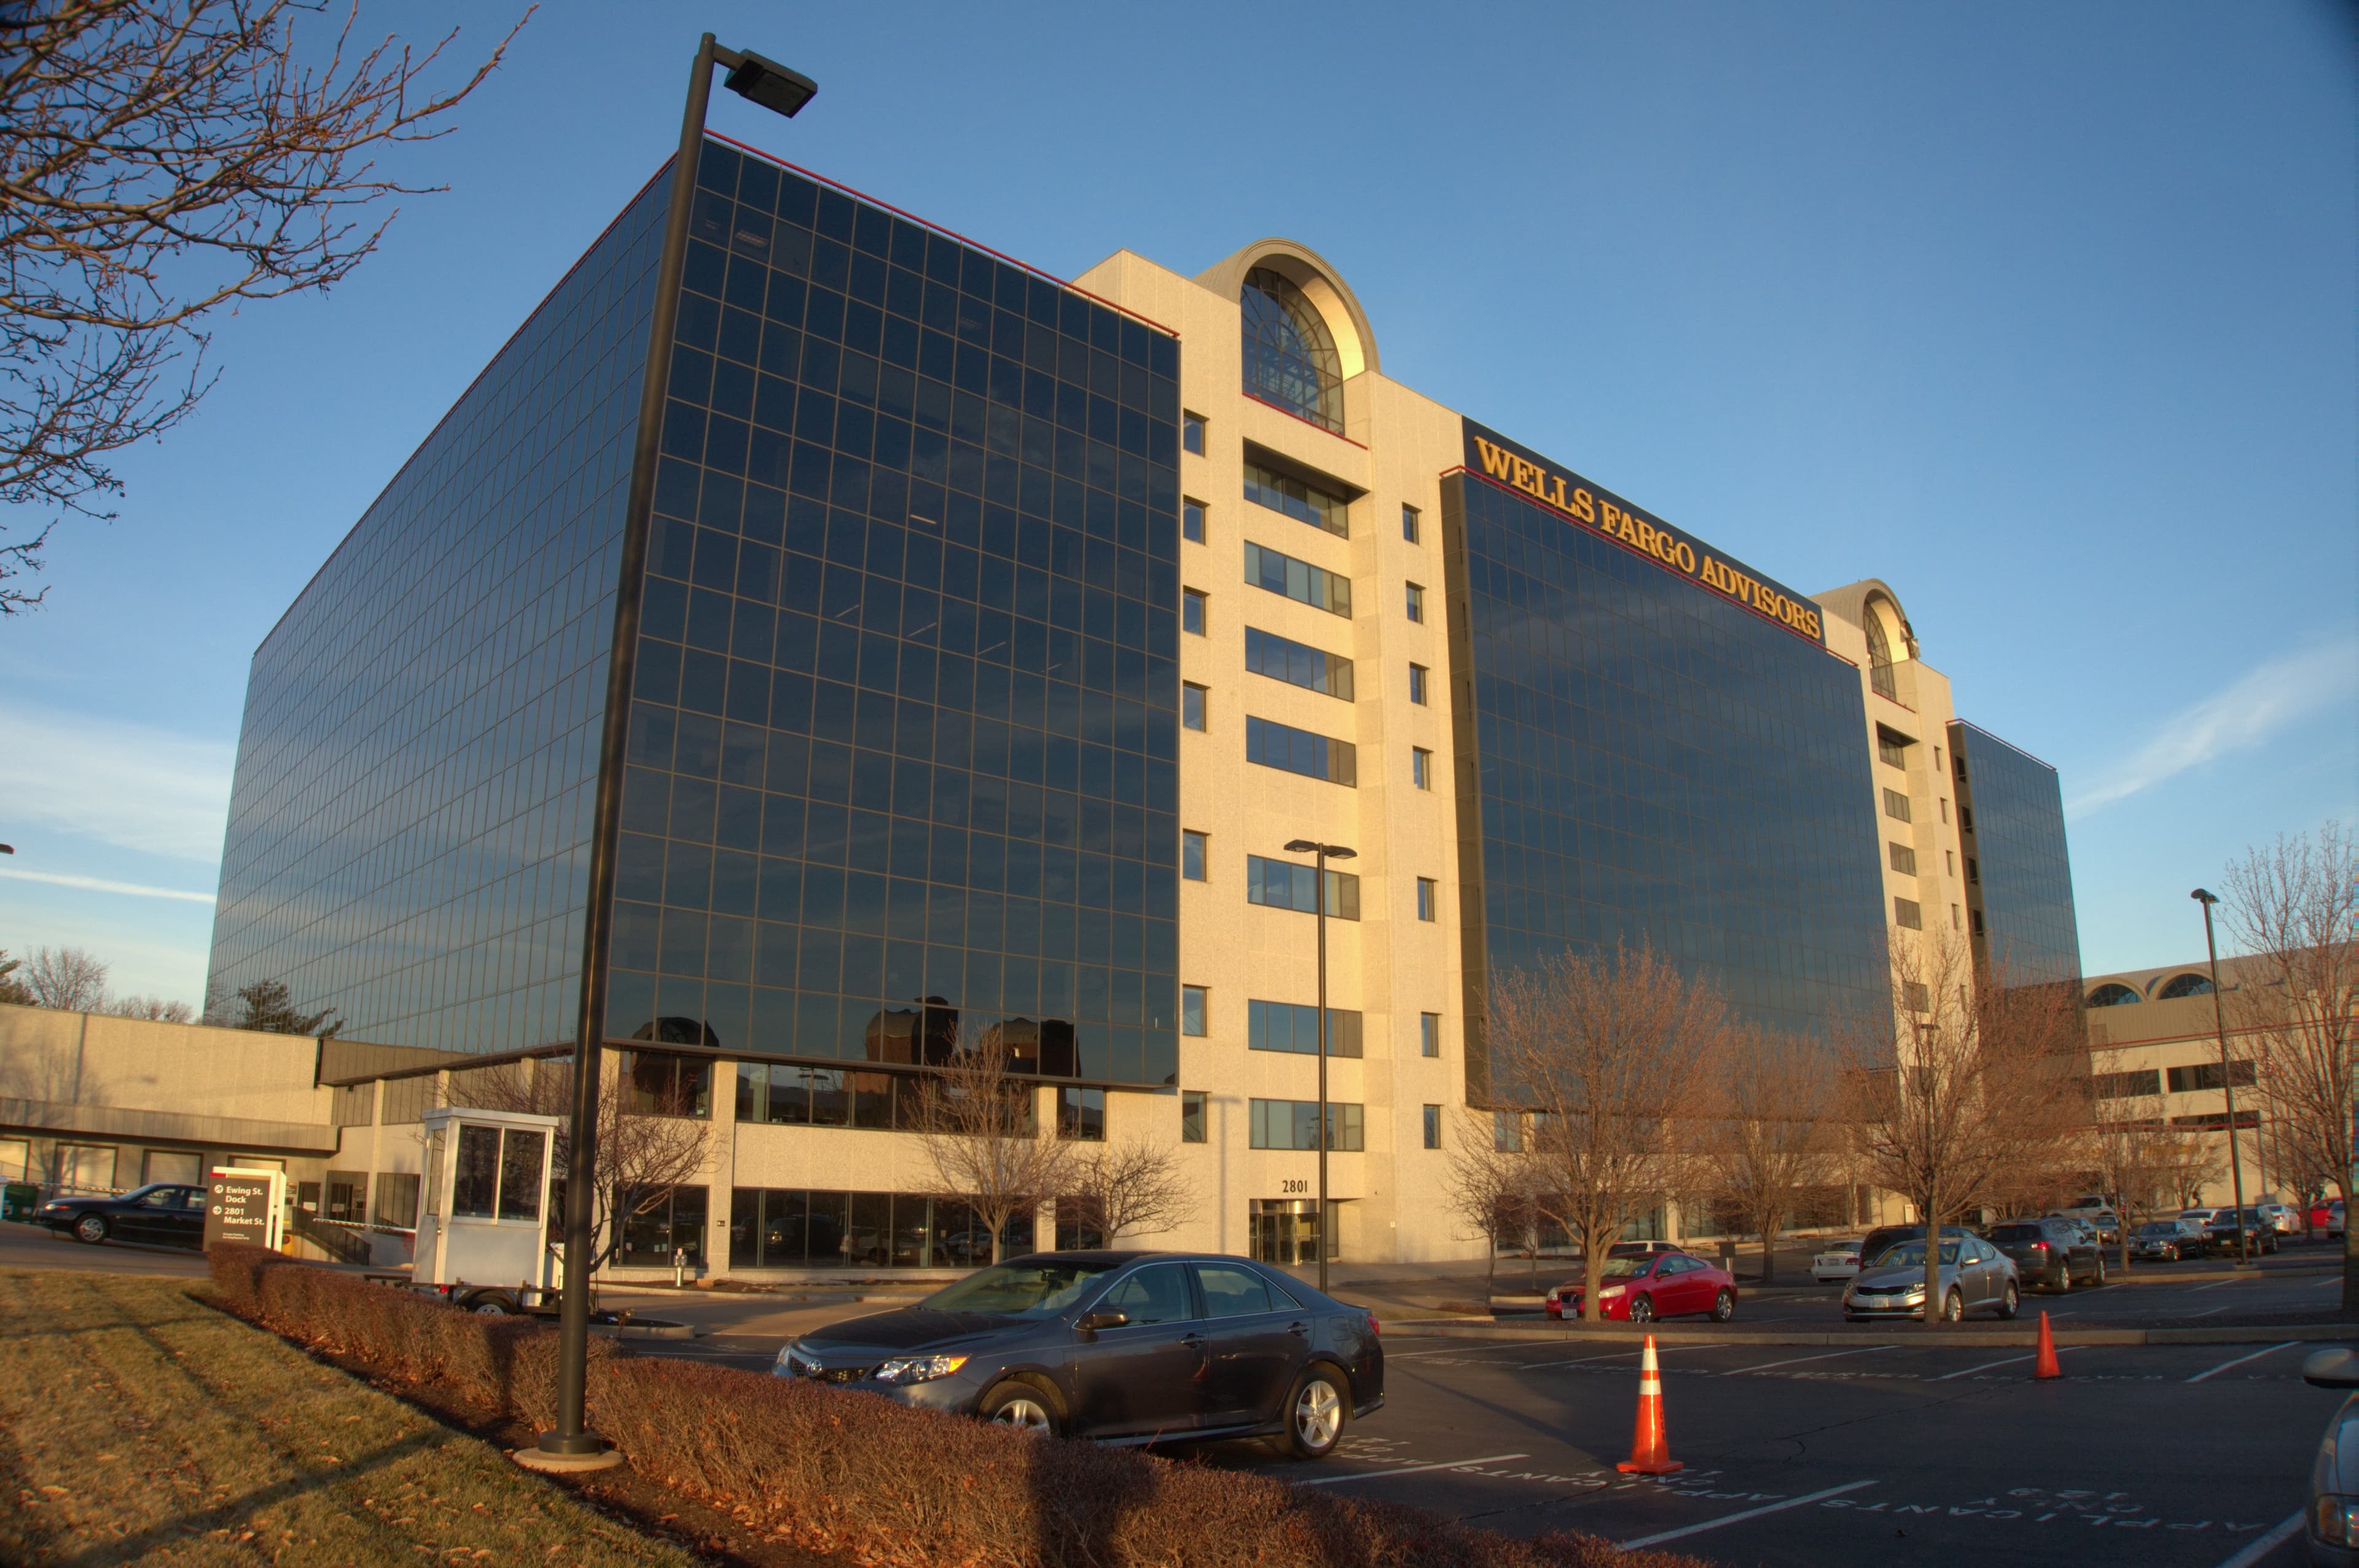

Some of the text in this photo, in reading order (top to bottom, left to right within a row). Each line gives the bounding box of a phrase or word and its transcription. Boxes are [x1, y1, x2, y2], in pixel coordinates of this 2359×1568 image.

[1474, 435, 1821, 640] WELLS FARGO ADVISORS
[226, 1186, 251, 1196] Ewing
[1282, 1180, 1307, 1193] 2801
[224, 1216, 252, 1225] Market
[1450, 1466, 1786, 1500] APPLICANTS
[1819, 1500, 2266, 1531] APPLICANTS
